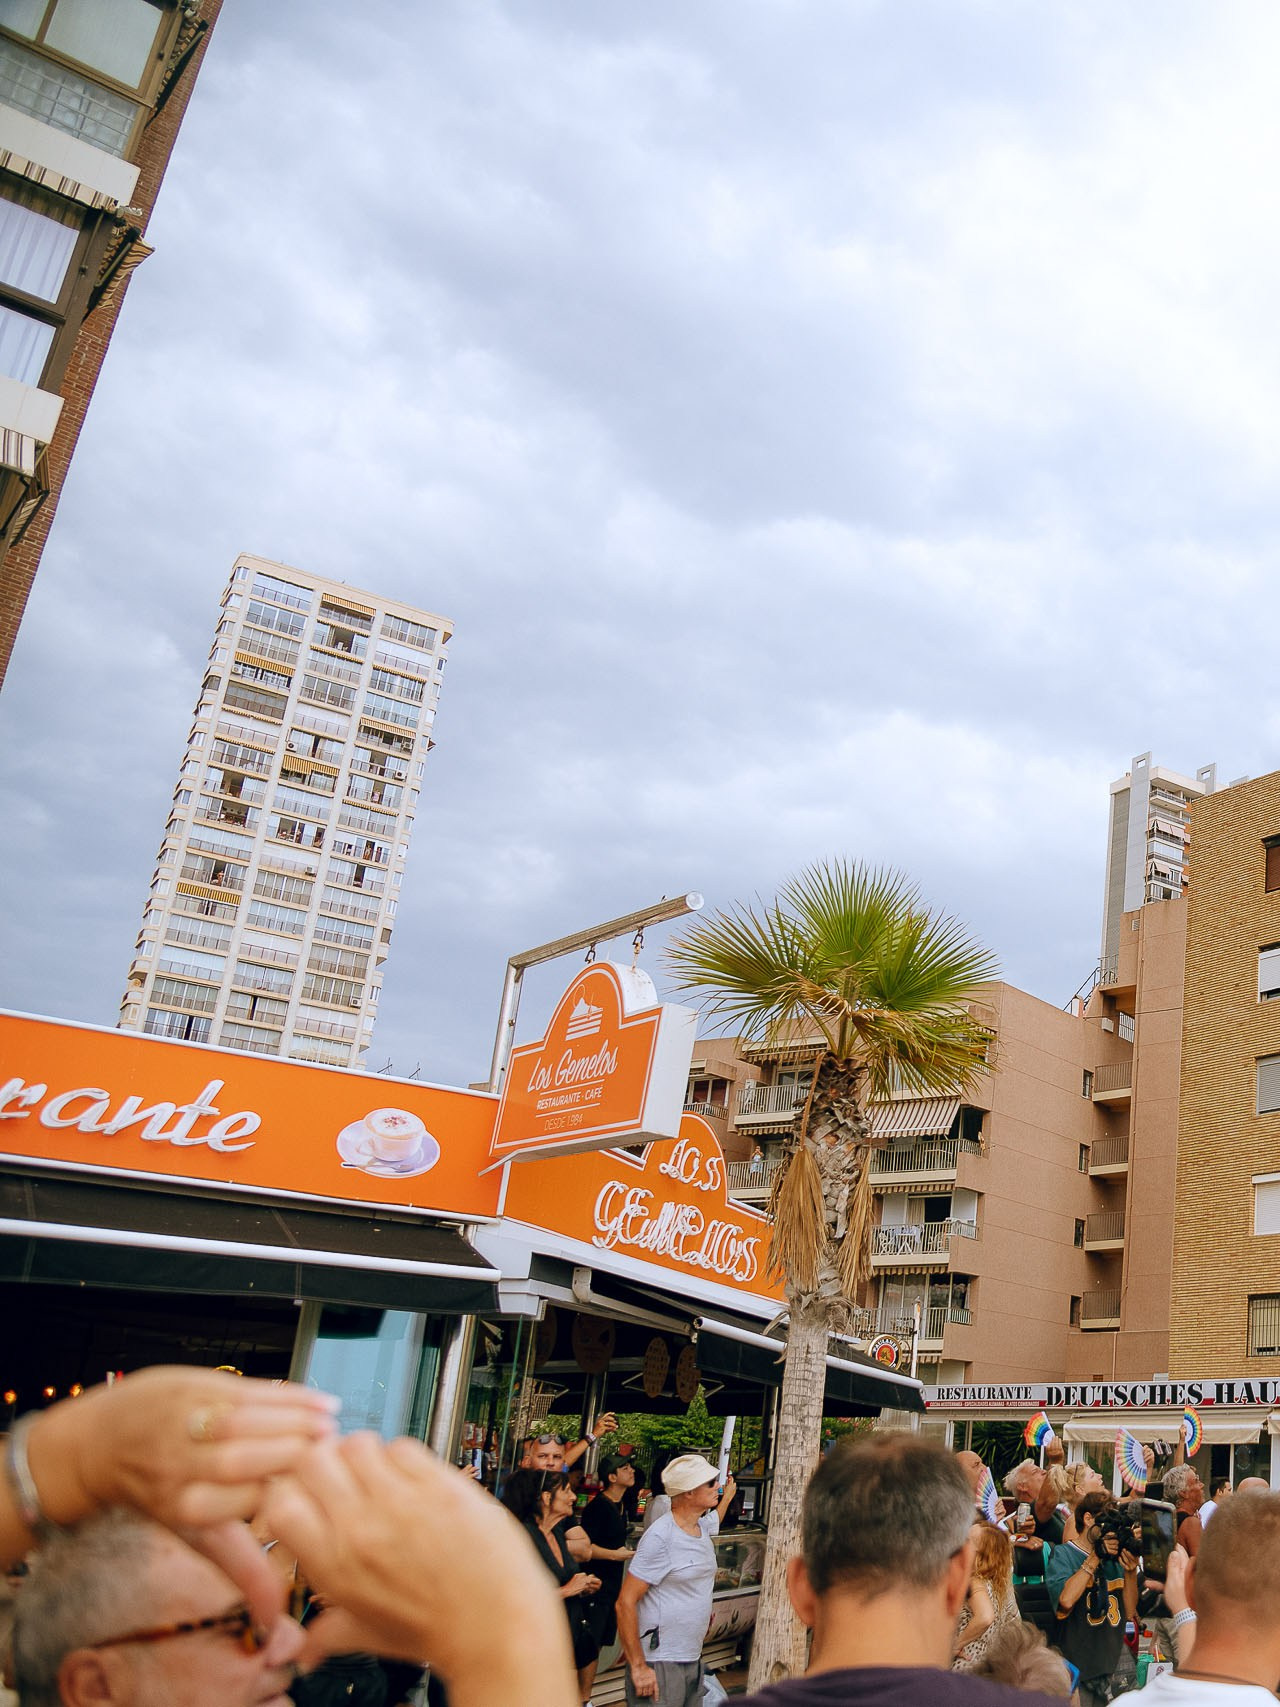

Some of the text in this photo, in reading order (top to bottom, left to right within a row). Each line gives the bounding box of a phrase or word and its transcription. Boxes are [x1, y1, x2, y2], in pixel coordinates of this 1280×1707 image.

[527, 1039, 619, 1093] Los Gemelos
[536, 1092, 581, 1111] RESTAURANTE
[0, 1077, 262, 1152] rante
[543, 1115, 566, 1131] DESDE
[936, 1386, 1032, 1400] RESTAURANTE
[1045, 1382, 1204, 1407] DEUTSCHES
